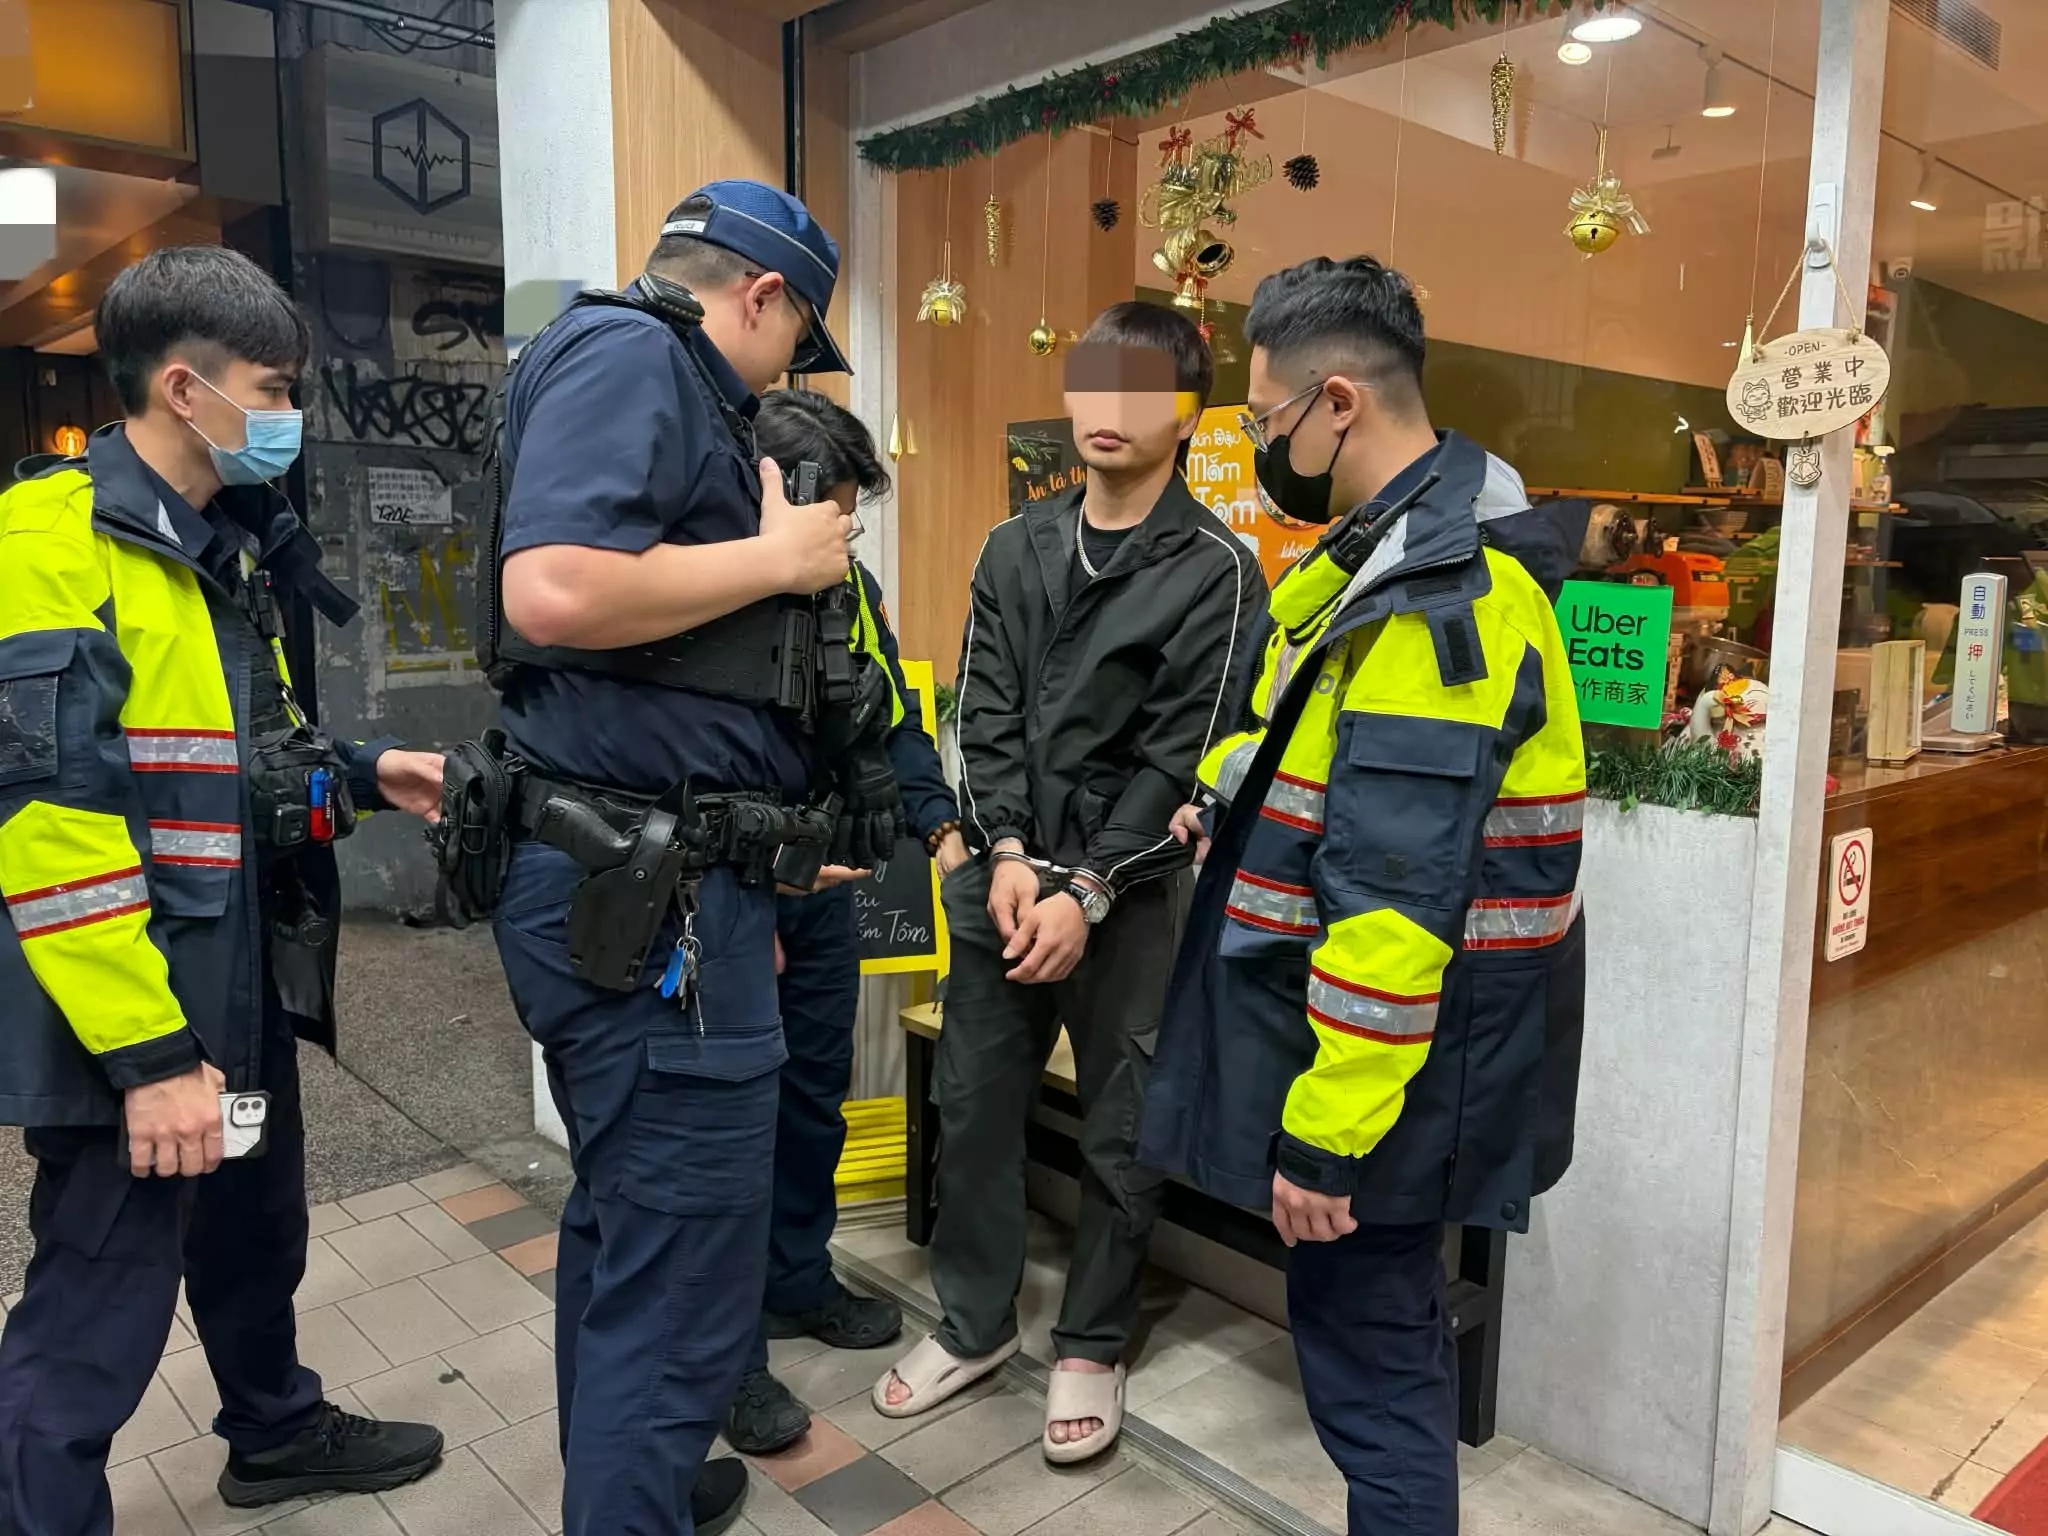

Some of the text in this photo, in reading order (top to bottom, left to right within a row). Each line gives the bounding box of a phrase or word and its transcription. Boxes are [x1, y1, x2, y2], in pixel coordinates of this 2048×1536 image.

[1781, 355, 1864, 390] 營業中
[1777, 384, 1873, 418] 歡迎光臨
[1049, 472, 1067, 491] là
[1186, 452, 1240, 484] Mắm
[1970, 585, 1986, 620] 自動
[1572, 604, 1648, 636] Uber
[1964, 628, 1989, 637] PRESS
[1567, 638, 1644, 671] Eats
[882, 909, 929, 945] Tôm
